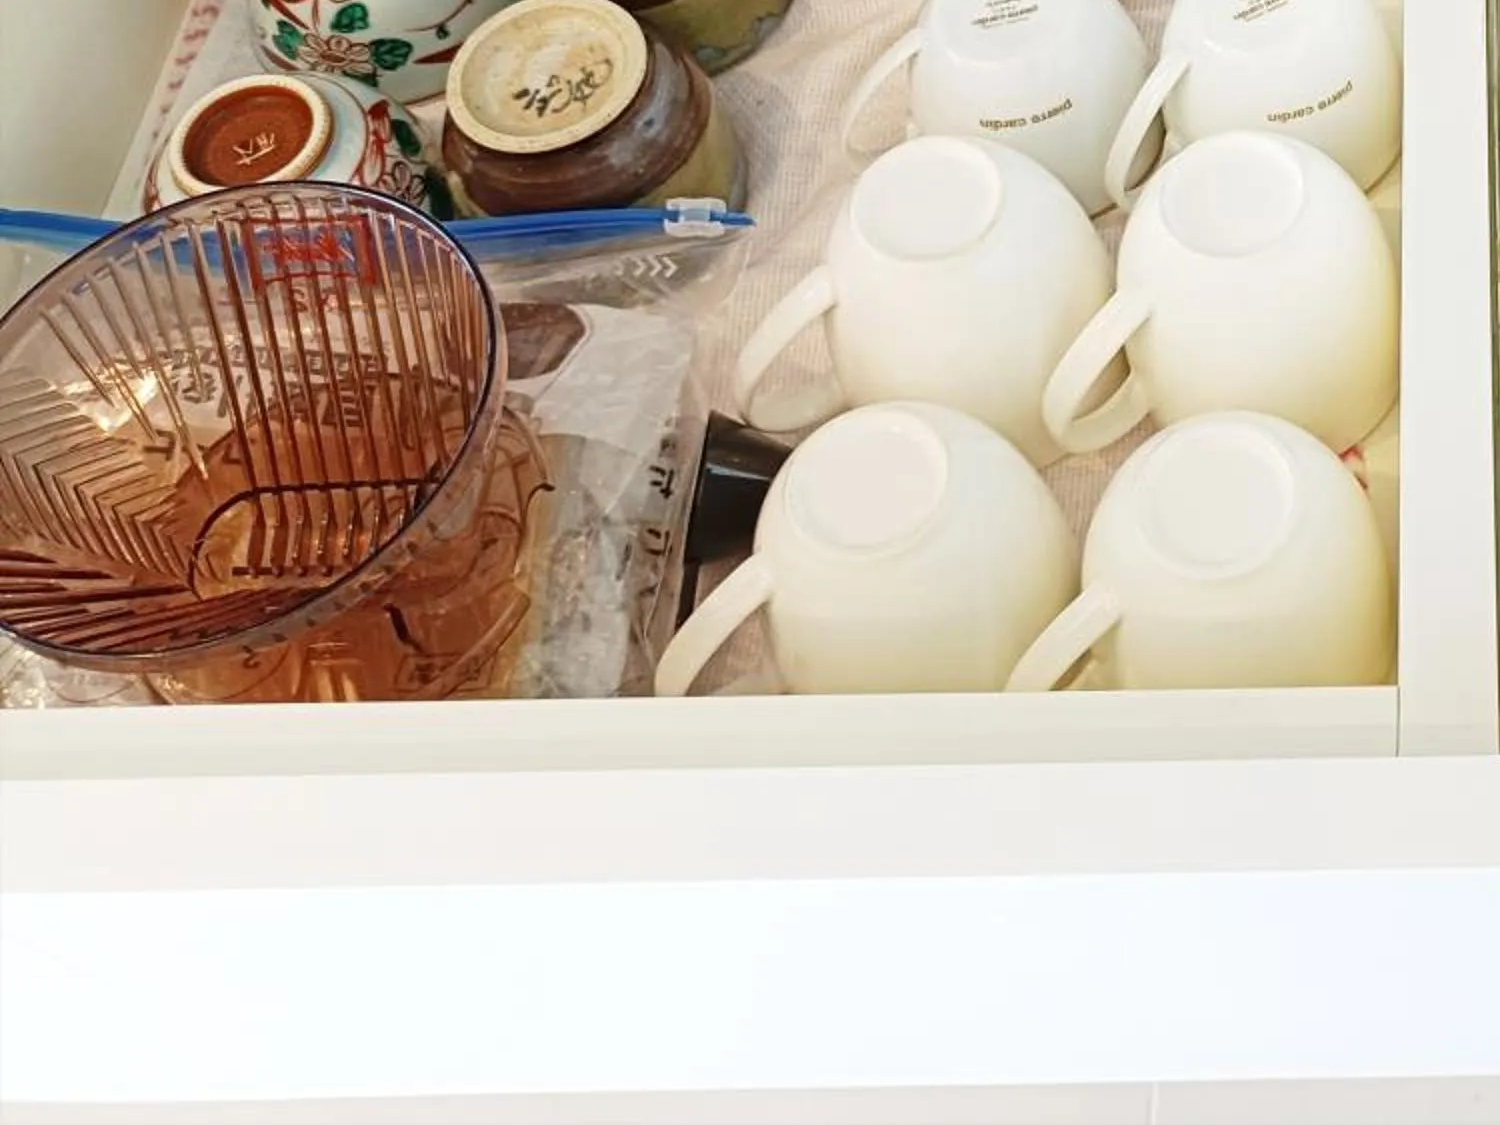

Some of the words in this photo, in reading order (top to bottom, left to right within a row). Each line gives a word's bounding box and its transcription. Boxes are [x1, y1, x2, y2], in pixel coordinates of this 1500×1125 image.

[1316, 80, 1355, 111] pierre
[978, 114, 1028, 132] cardin
[1030, 97, 1074, 125] pierre
[1267, 104, 1316, 124] cardin
